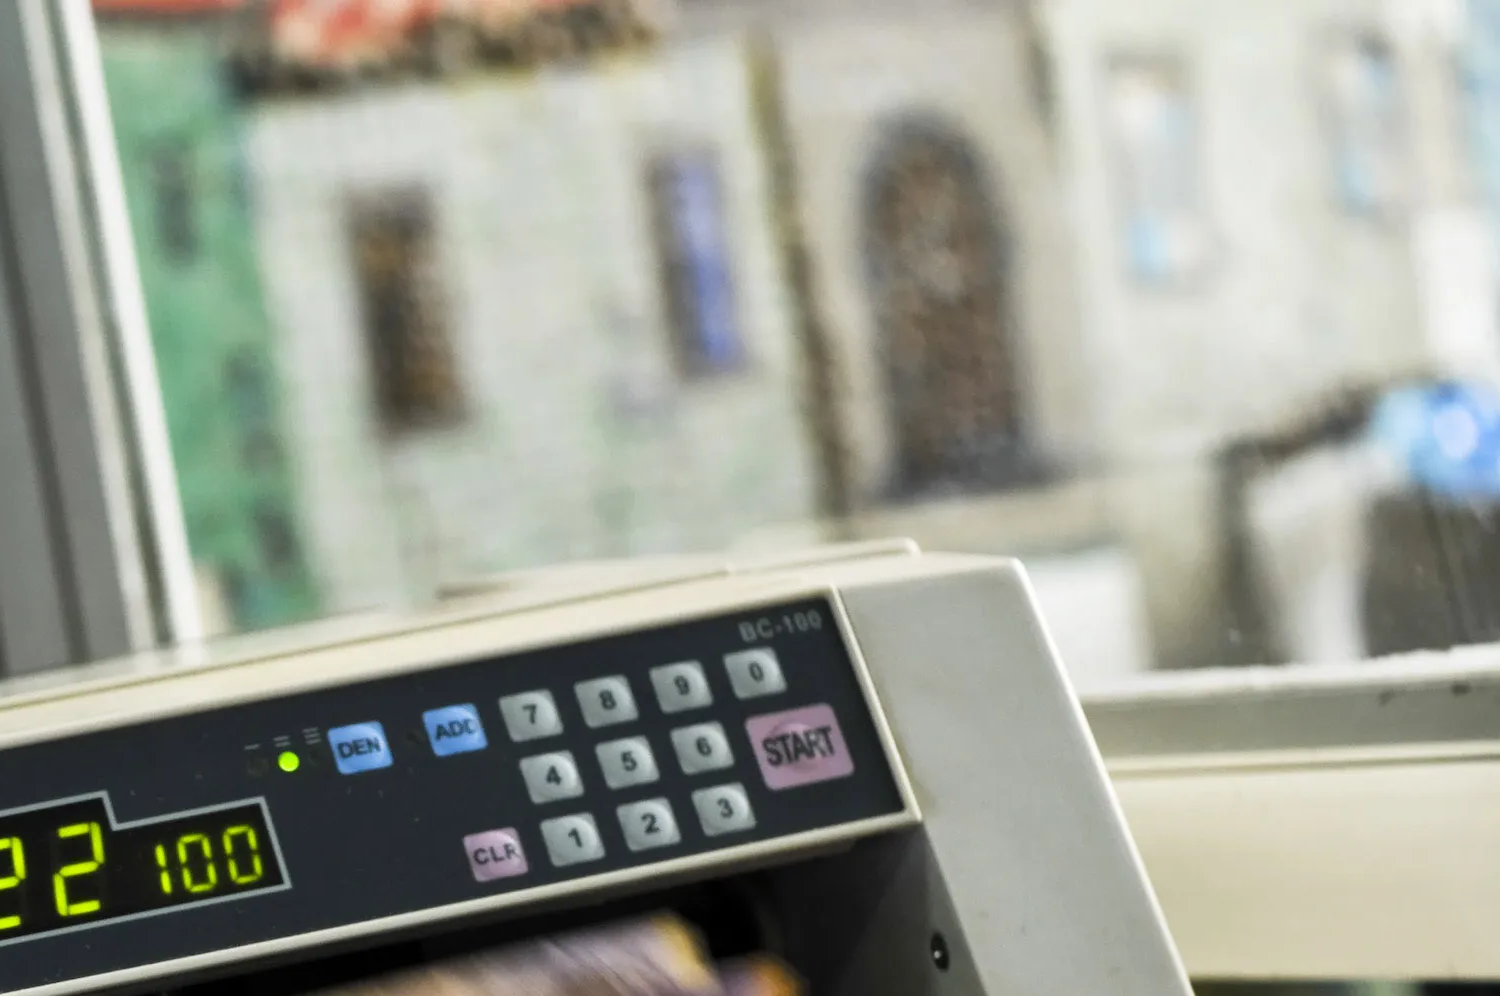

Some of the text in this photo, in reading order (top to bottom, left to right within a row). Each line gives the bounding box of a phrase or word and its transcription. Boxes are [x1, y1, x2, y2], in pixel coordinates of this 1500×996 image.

[738, 609, 823, 643] BC-100
[522, 661, 764, 725] 7 8 9 0
[336, 737, 381, 759] DEN
[546, 737, 712, 786] 4 5 6
[762, 726, 836, 767] START
[568, 797, 733, 849] 1 2 3
[155, 825, 264, 894] 100
[472, 845, 517, 866] CLR
